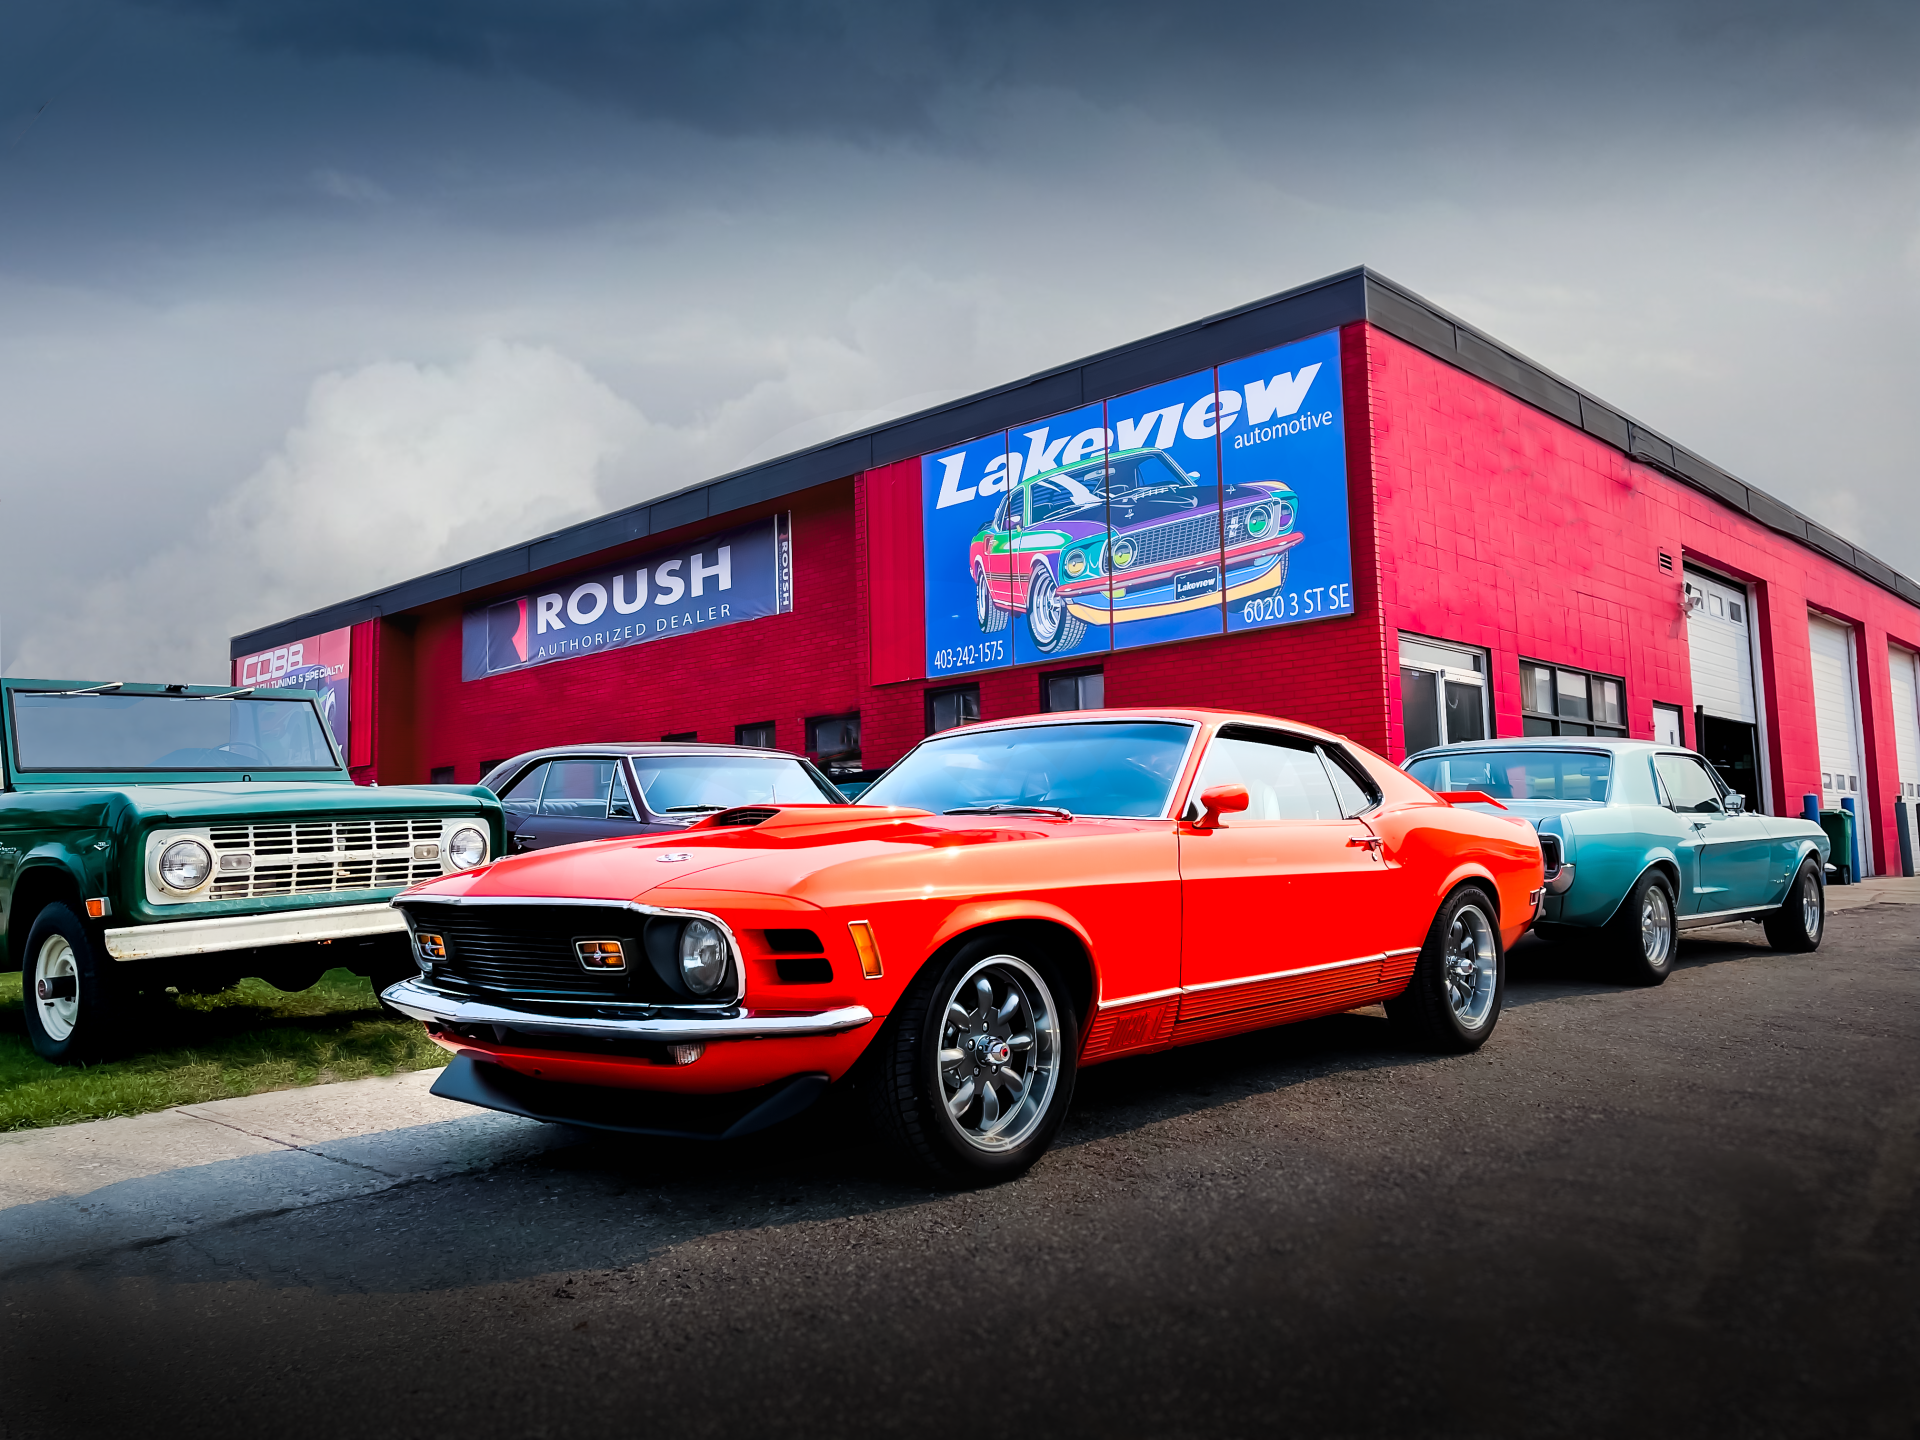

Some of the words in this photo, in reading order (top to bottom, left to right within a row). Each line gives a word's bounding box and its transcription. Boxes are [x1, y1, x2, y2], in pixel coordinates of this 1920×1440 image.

[936, 362, 1322, 509] Lakeview
[1234, 411, 1333, 449] automotive
[536, 545, 732, 635] ROUSH
[782, 541, 790, 606] ROUSH
[1243, 595, 1284, 623] 6020
[1289, 593, 1299, 616] 3
[1304, 587, 1324, 614] ST
[1329, 583, 1350, 609] SE
[537, 623, 647, 659] AUTHORIZED
[656, 604, 731, 632] DEALER
[242, 644, 303, 686] COBB
[305, 663, 345, 682] SPECIALTY
[934, 640, 1004, 669] 403-242-1575
